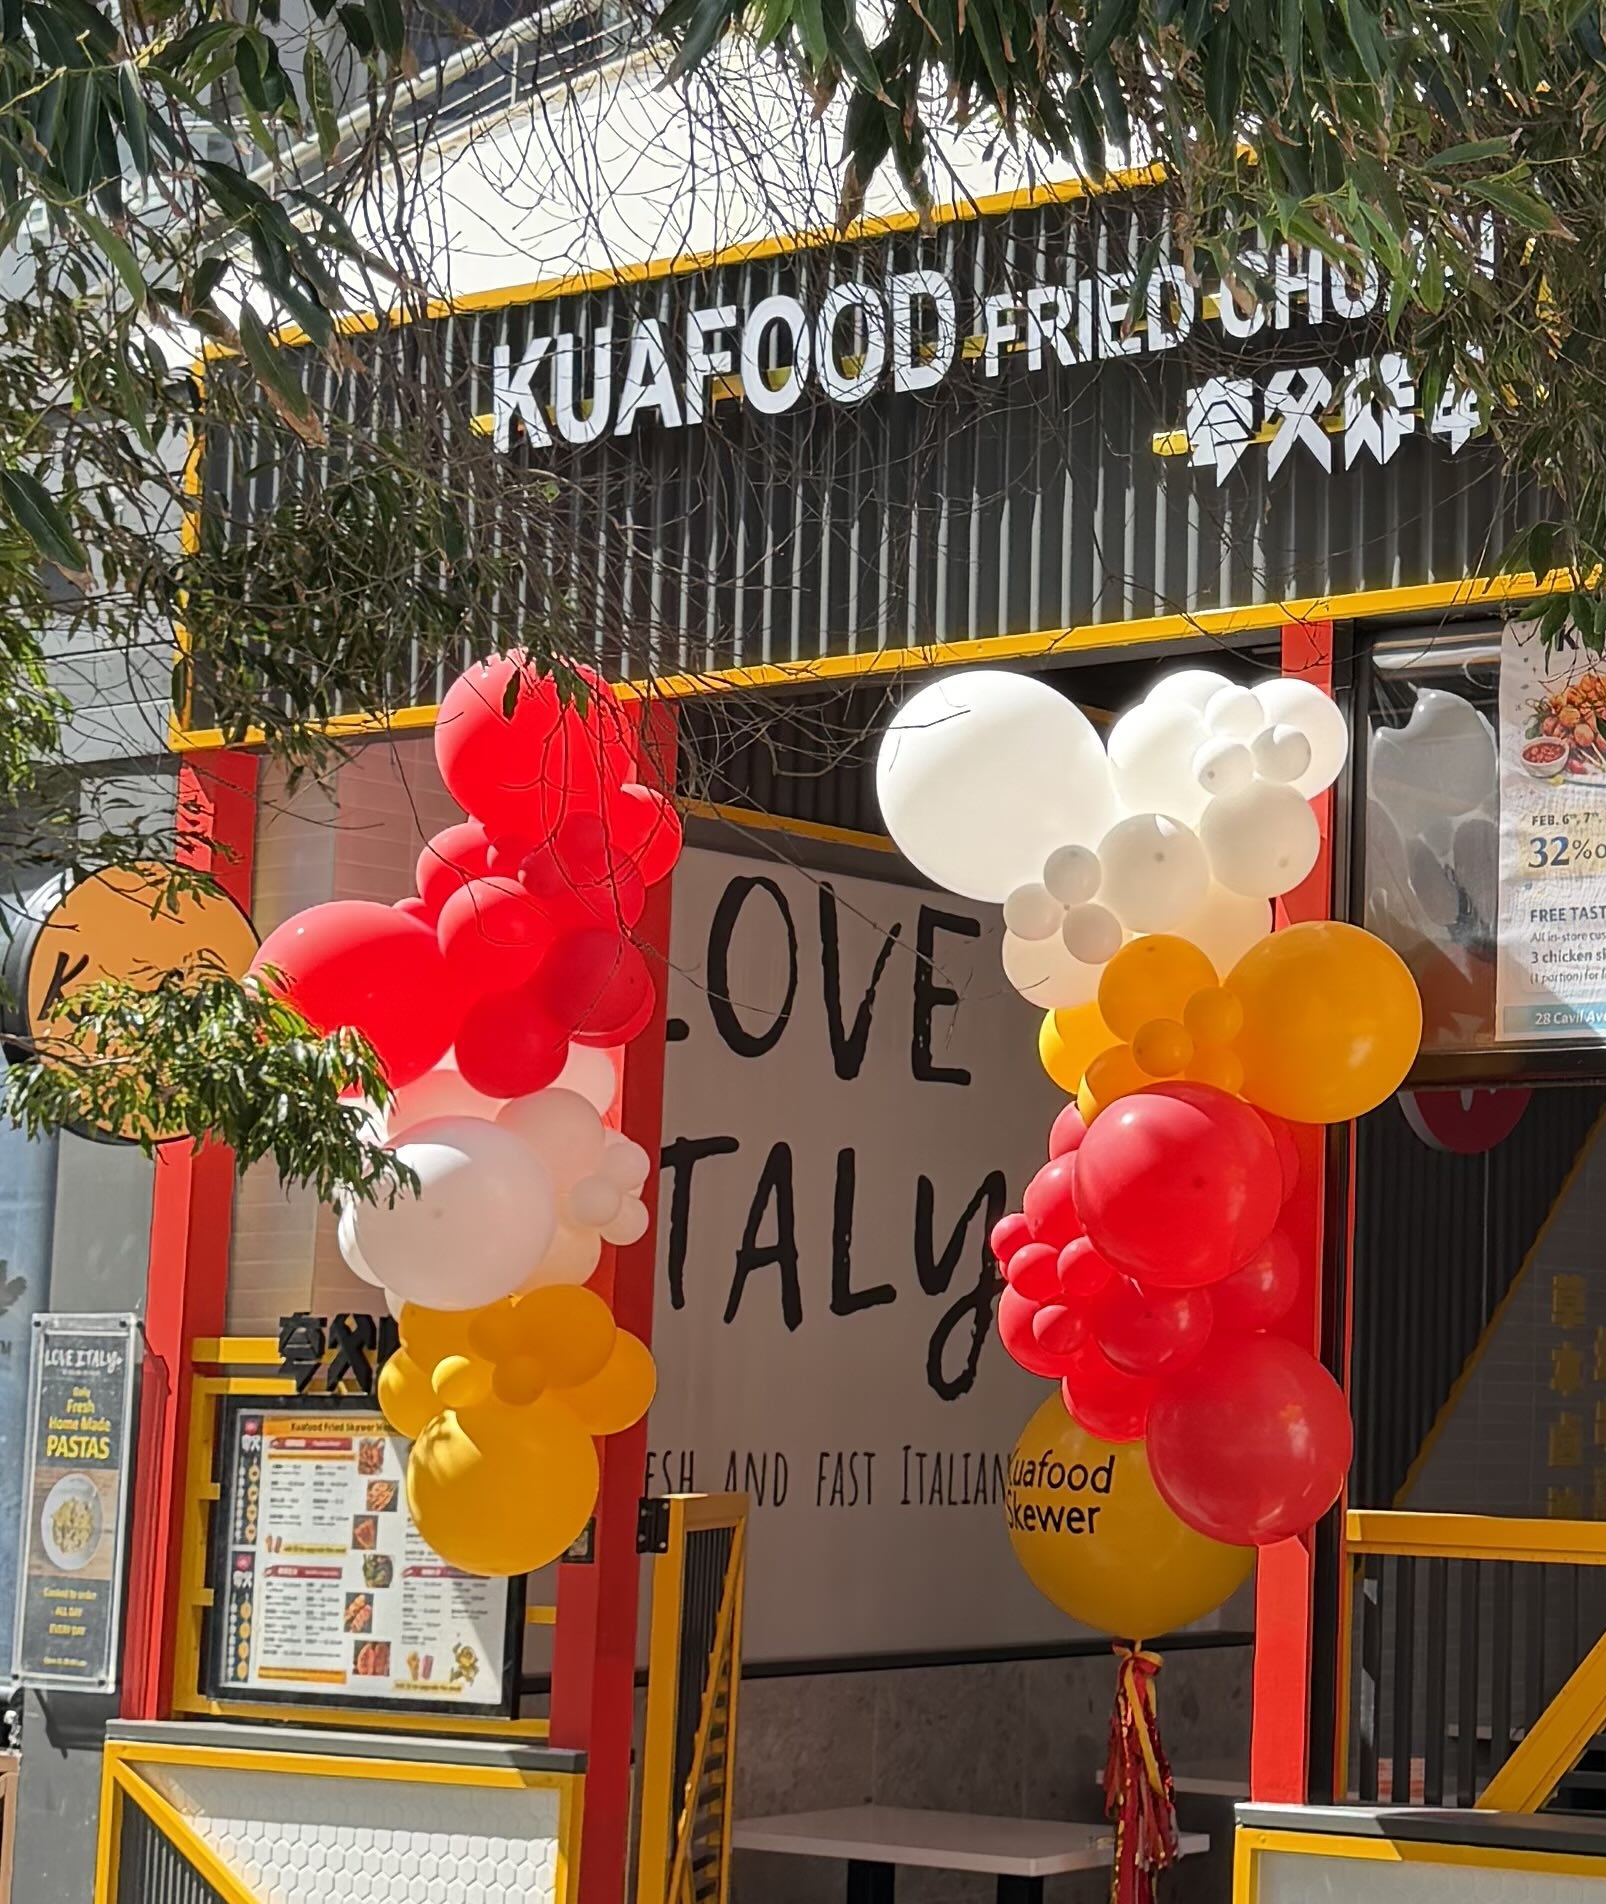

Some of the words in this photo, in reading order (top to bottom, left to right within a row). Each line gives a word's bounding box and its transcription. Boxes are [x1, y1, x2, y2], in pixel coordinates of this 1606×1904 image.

[491, 270, 958, 454] KUAFOOD
[984, 263, 1196, 378] FRIED
[1531, 815, 1560, 827] FEB.
[1530, 907, 1566, 923] FREE
[1530, 951, 1539, 964] 3
[1542, 948, 1593, 964] chicken
[666, 876, 981, 1087] OVE
[1584, 967, 1599, 981] for
[1535, 1012, 1551, 1025] 28
[66, 1398, 96, 1414] Fresh
[46, 1434, 111, 1460] PASTAS
[644, 1450, 694, 1499] ESH
[724, 1449, 789, 1508] AND
[815, 1450, 876, 1507] FAST
[1007, 1448, 1116, 1495] Kuafood
[1007, 1488, 1101, 1534] Skewer
